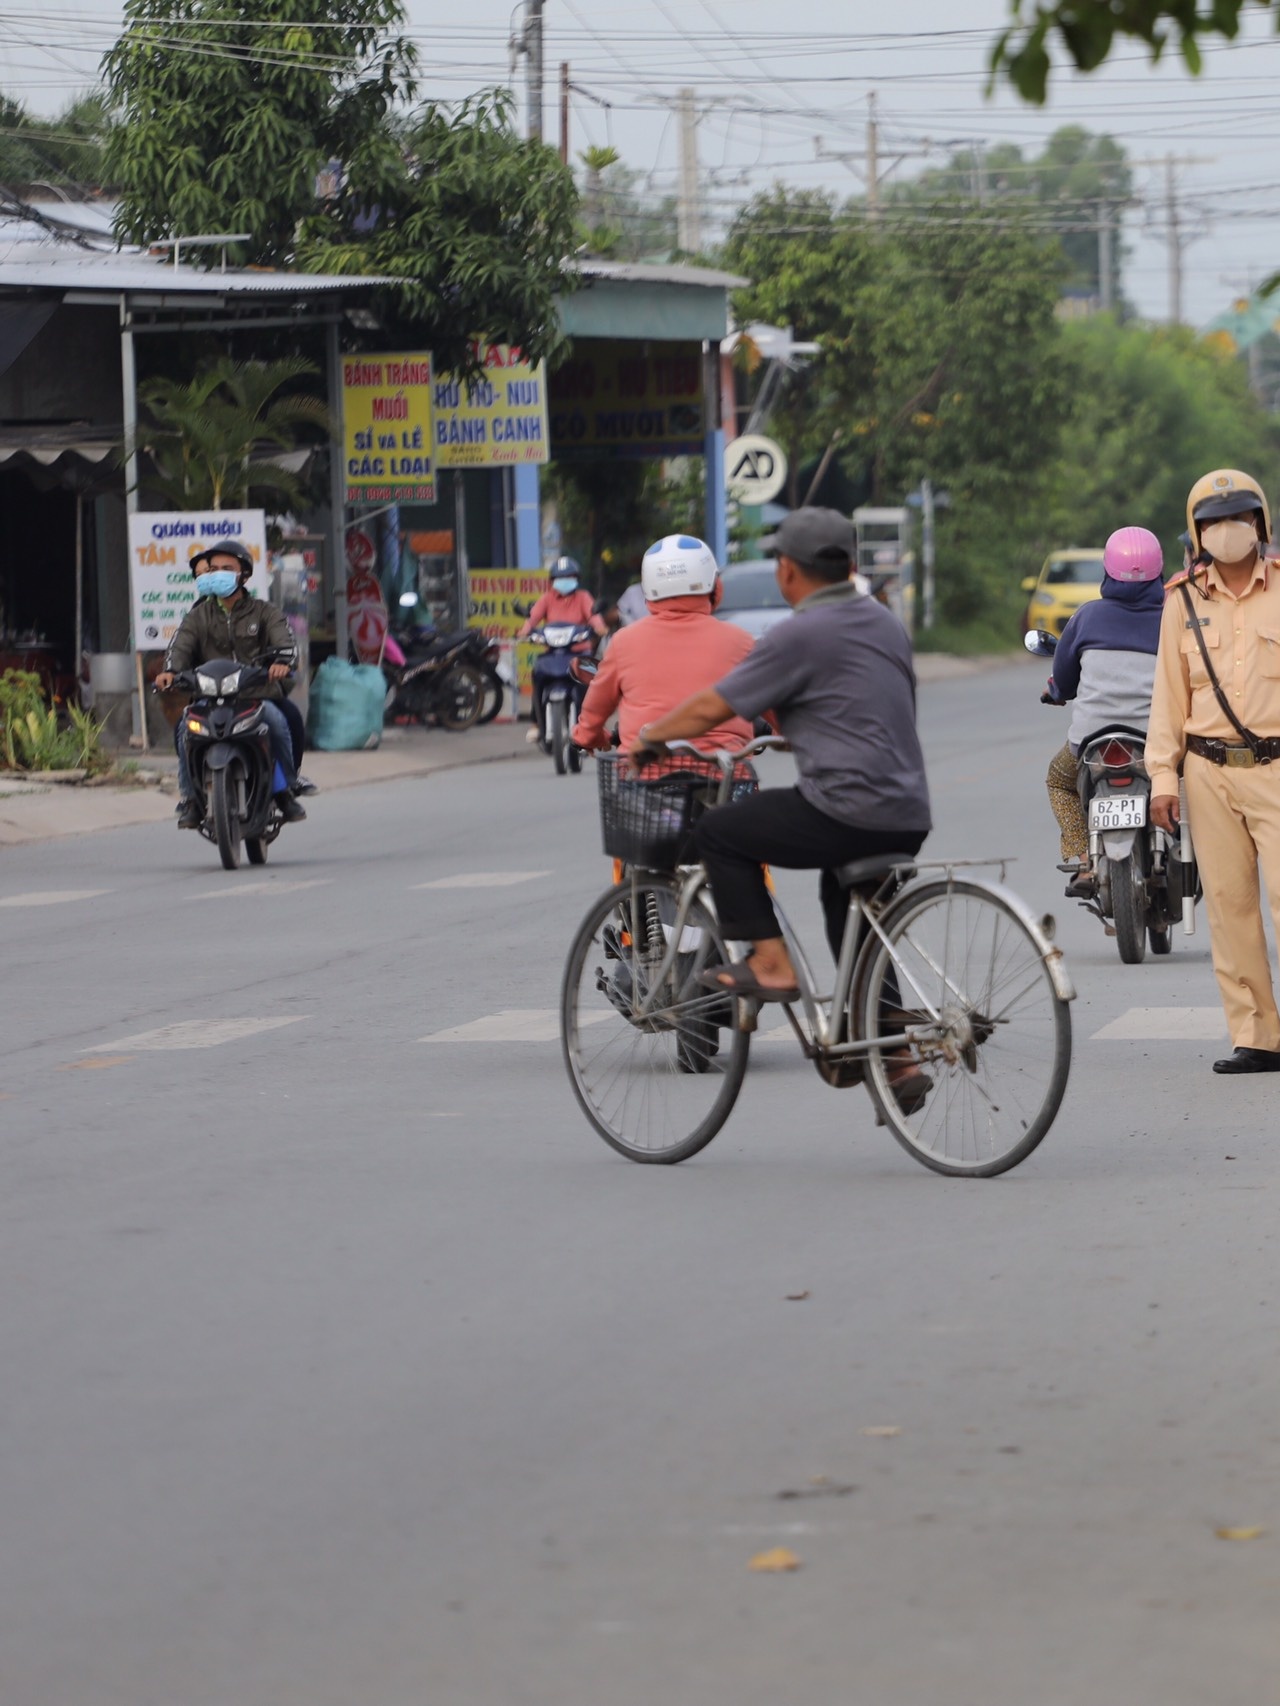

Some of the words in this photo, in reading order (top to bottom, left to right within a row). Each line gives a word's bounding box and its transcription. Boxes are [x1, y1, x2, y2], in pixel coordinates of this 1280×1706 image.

[507, 380, 539, 406] NUI
[436, 412, 486, 445] BÁNH
[492, 415, 542, 442] CANH
[348, 453, 384, 477] CÁC
[391, 456, 431, 480] LOẠI
[136, 541, 176, 566] TÂM
[1097, 799, 1136, 814] 62-P1
[1092, 812, 1142, 828] 800.36
